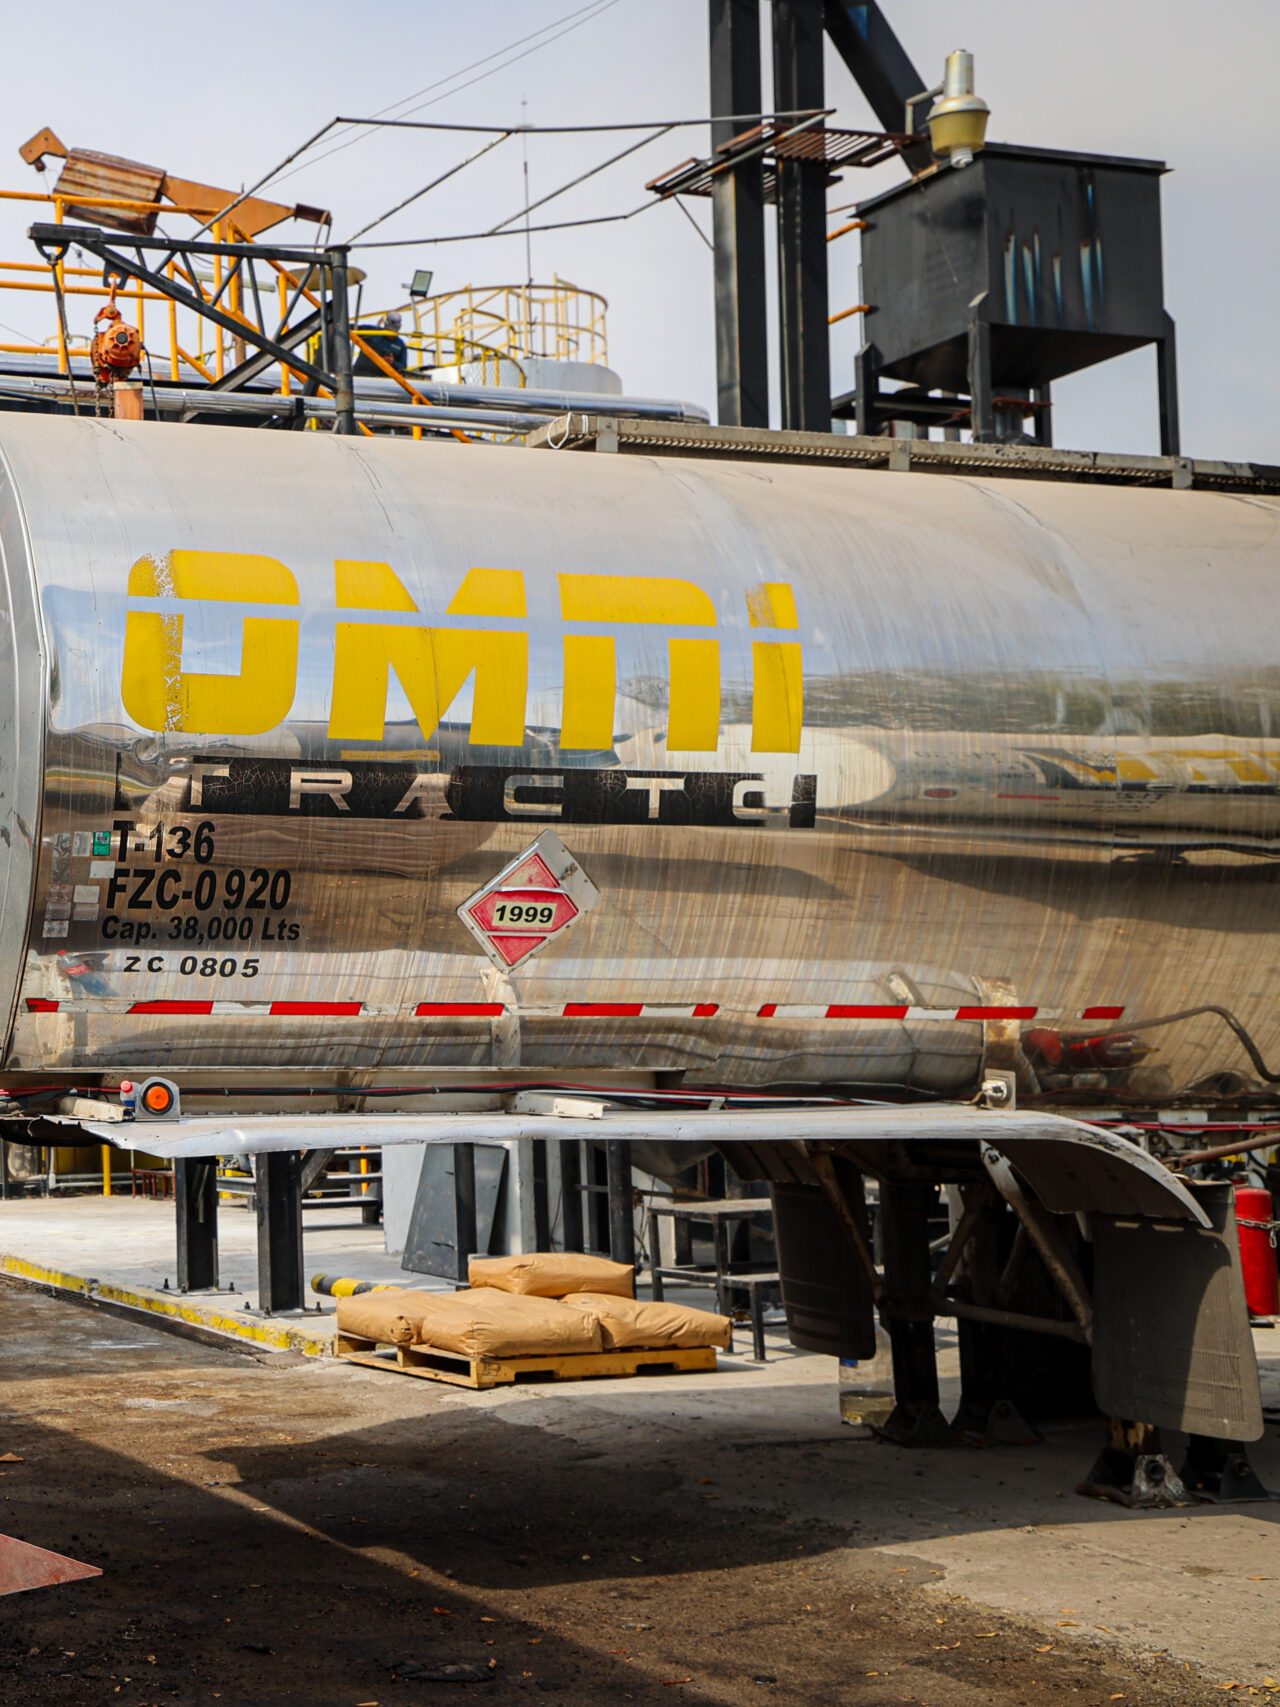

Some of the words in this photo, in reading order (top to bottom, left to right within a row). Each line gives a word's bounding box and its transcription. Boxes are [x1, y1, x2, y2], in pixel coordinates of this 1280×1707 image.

[113, 820, 215, 864] T-136
[494, 904, 554, 925] 1999
[101, 915, 157, 945] Cap.
[167, 916, 253, 945] 38,000
[261, 917, 301, 941] Lts
[123, 956, 165, 973] ZC
[180, 955, 260, 978] 0805
